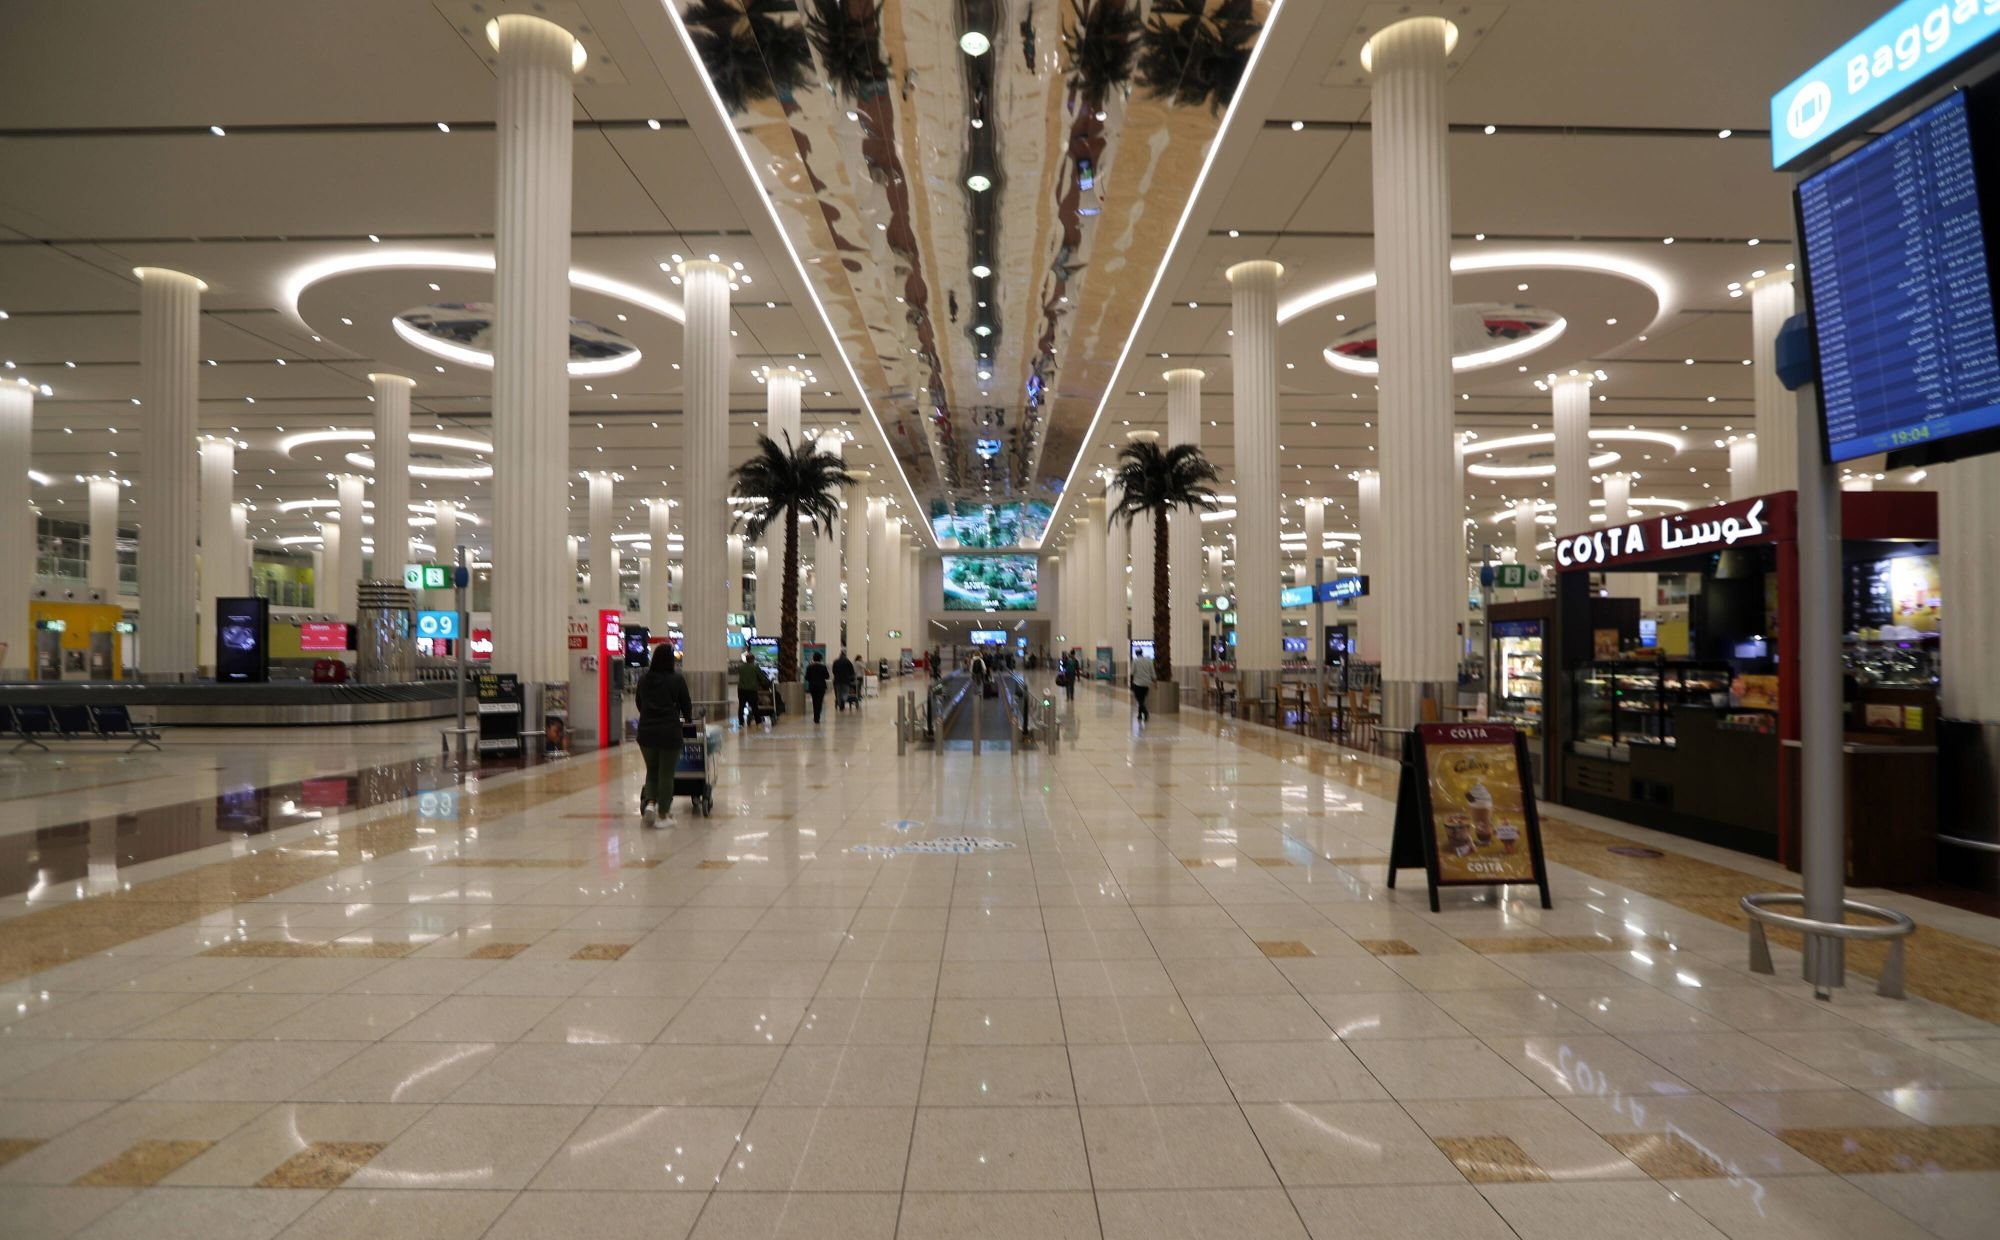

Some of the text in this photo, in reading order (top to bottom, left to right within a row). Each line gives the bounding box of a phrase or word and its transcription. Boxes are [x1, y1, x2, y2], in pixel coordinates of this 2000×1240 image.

[1892, 426, 1929, 446] 19:04
[1661, 499, 1764, 550] كوستا
[1557, 524, 1645, 567] COSTA
[1450, 728, 1488, 740] COSTA
[1467, 862, 1505, 873] COSTA
